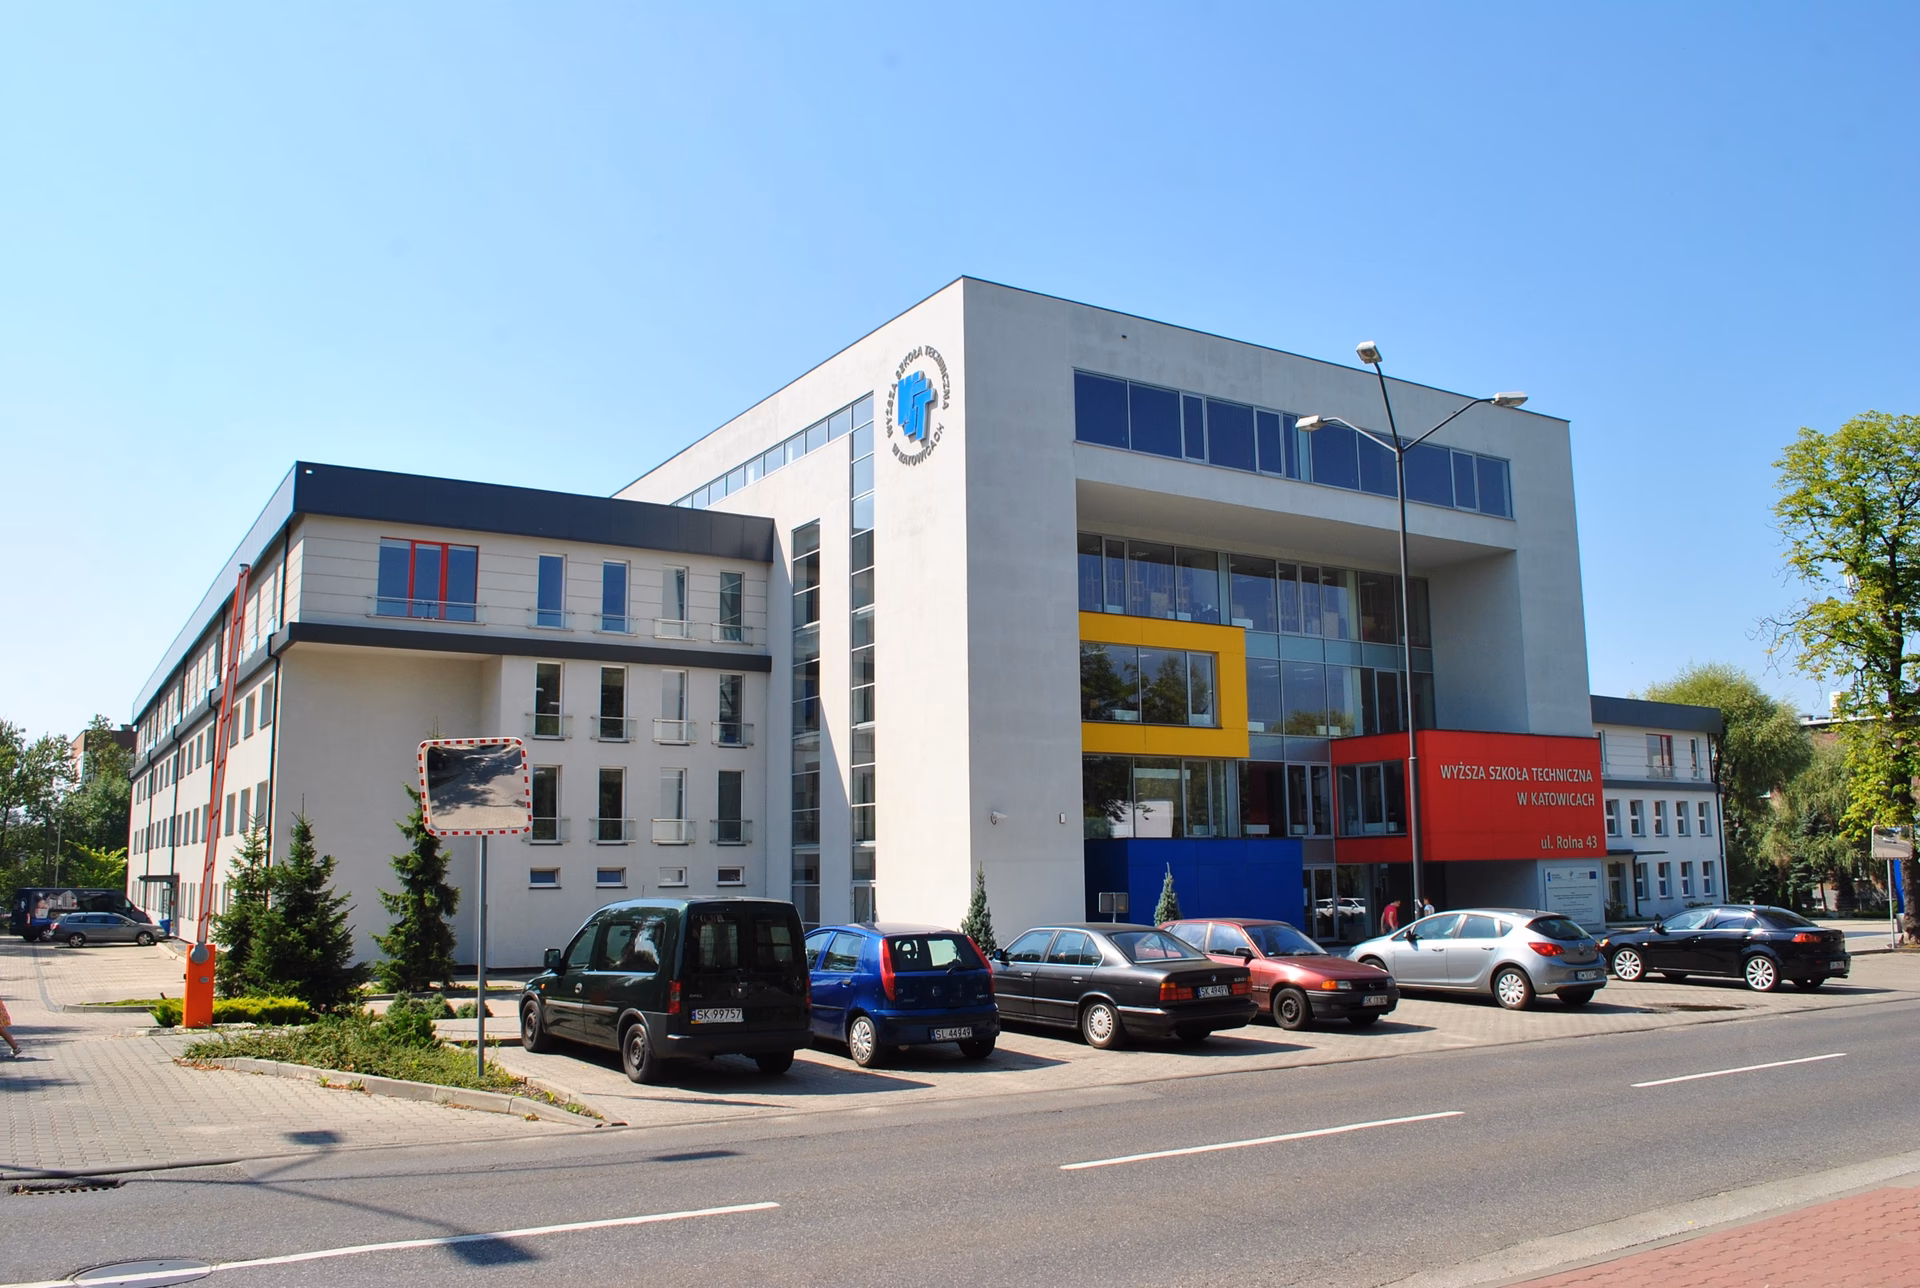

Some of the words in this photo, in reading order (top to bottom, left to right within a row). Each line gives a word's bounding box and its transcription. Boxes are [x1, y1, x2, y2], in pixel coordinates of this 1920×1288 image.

[924, 345, 951, 410] TECHNICZNA
[898, 422, 945, 466] KATOWICACH
[1440, 762, 1486, 780] WYŻSZA
[1489, 766, 1529, 781] SZKOŁA
[1532, 767, 1593, 782] TECHNICZNA
[1517, 792, 1528, 806] W
[1531, 792, 1595, 806] KATOWICACH
[1541, 835, 1553, 849] ul.
[1556, 835, 1583, 849] Rolna
[1586, 836, 1598, 849] 43
[697, 1009, 710, 1020] SK
[713, 1009, 742, 1019] 99757
[935, 1029, 947, 1039] SL
